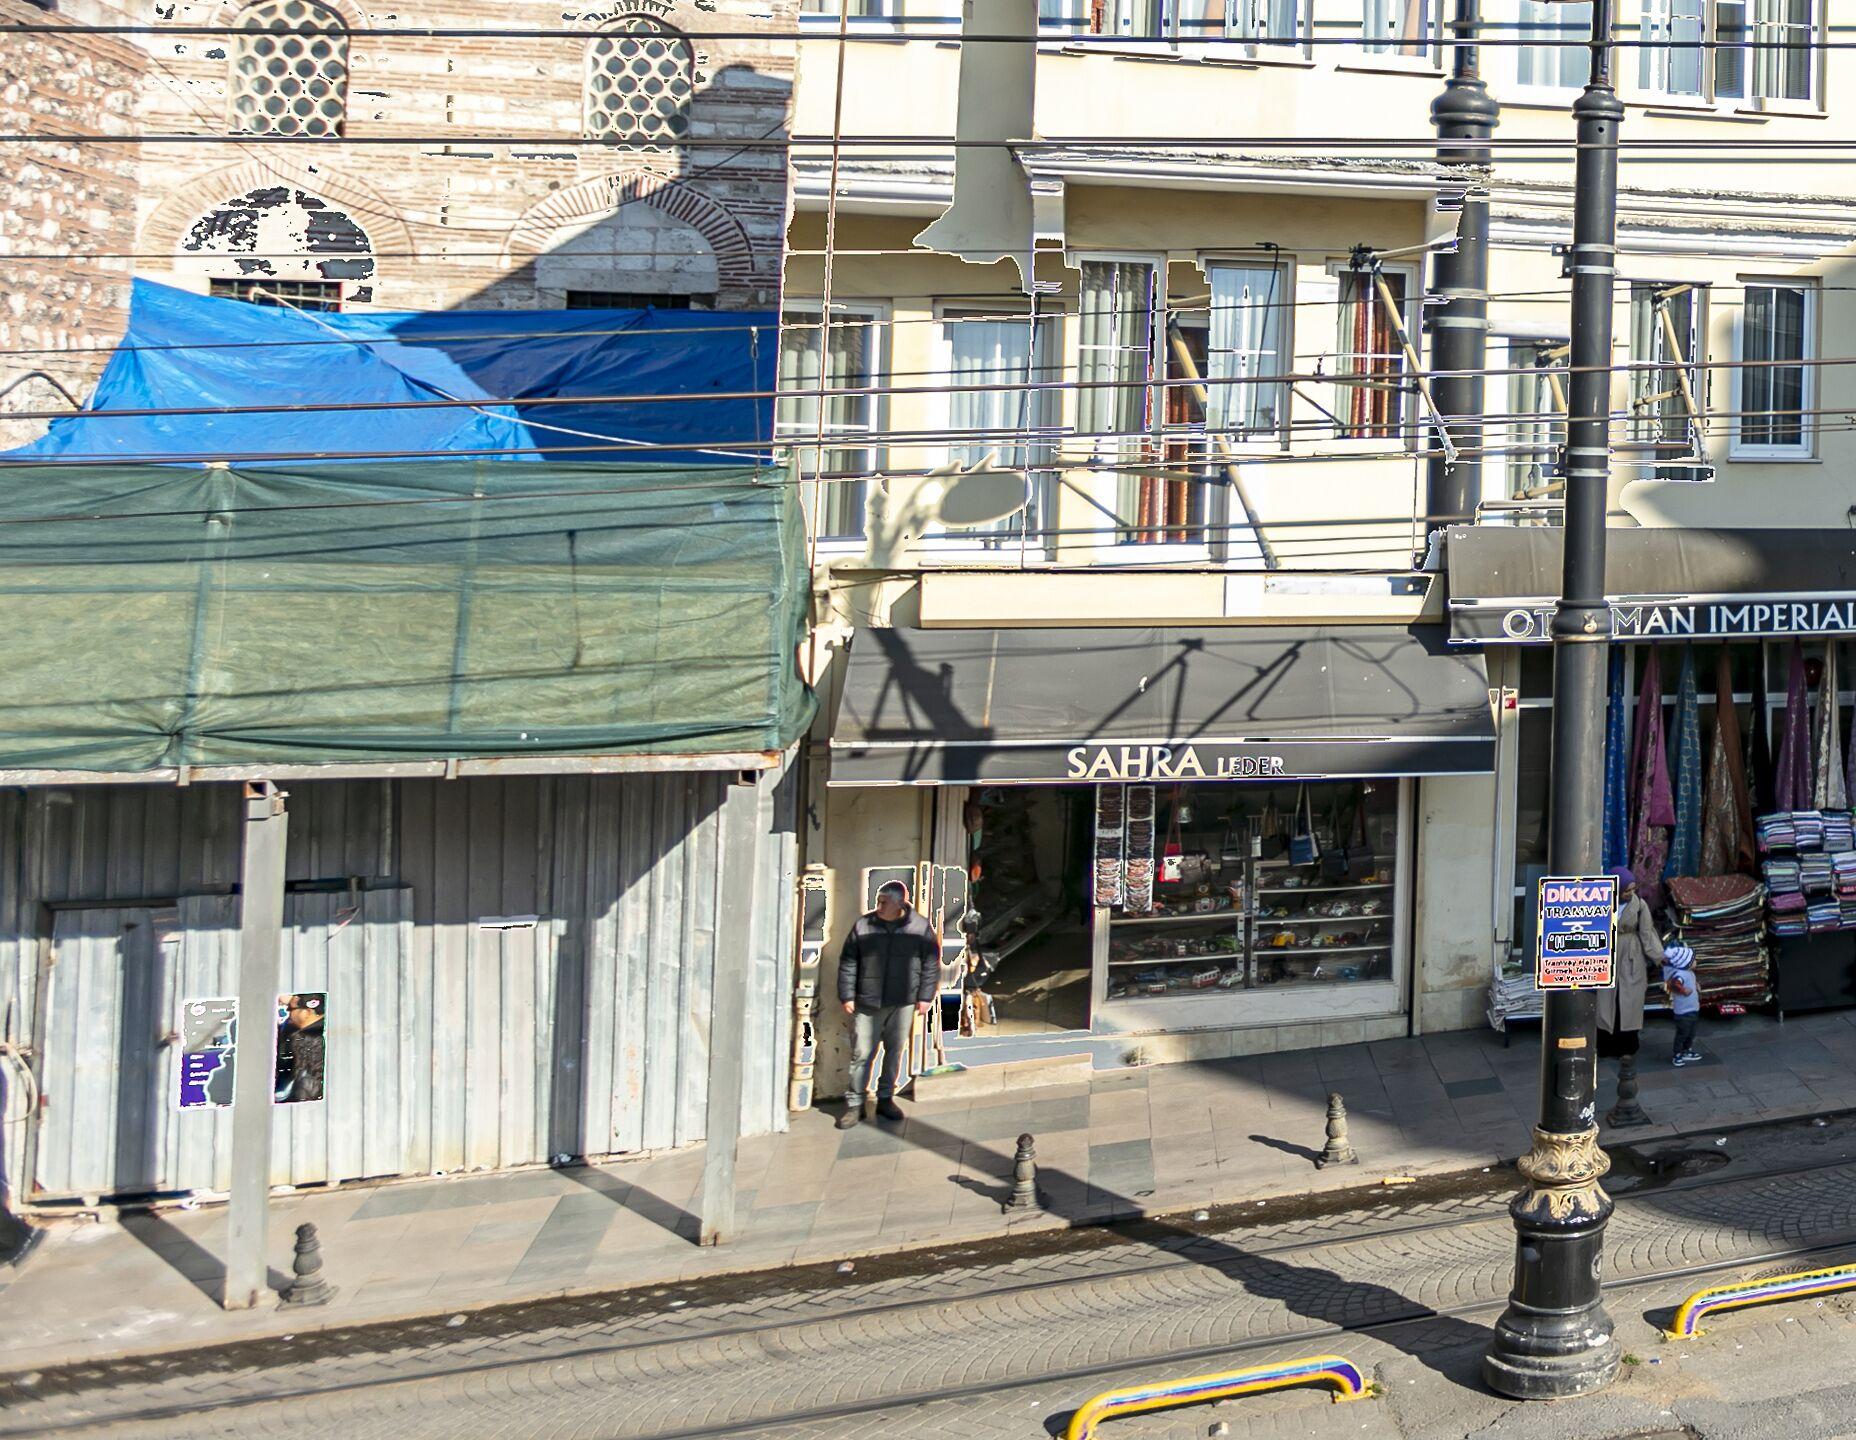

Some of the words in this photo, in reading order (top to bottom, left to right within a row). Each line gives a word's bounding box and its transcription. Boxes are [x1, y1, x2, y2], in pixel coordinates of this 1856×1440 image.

[1503, 605, 1696, 638] OTMAN
[1068, 745, 1206, 778] SAHRA
[1217, 756, 1285, 776] LEDER
[1546, 885, 1612, 903] DİKKAT
[1545, 905, 1611, 919] TRAMVAY
